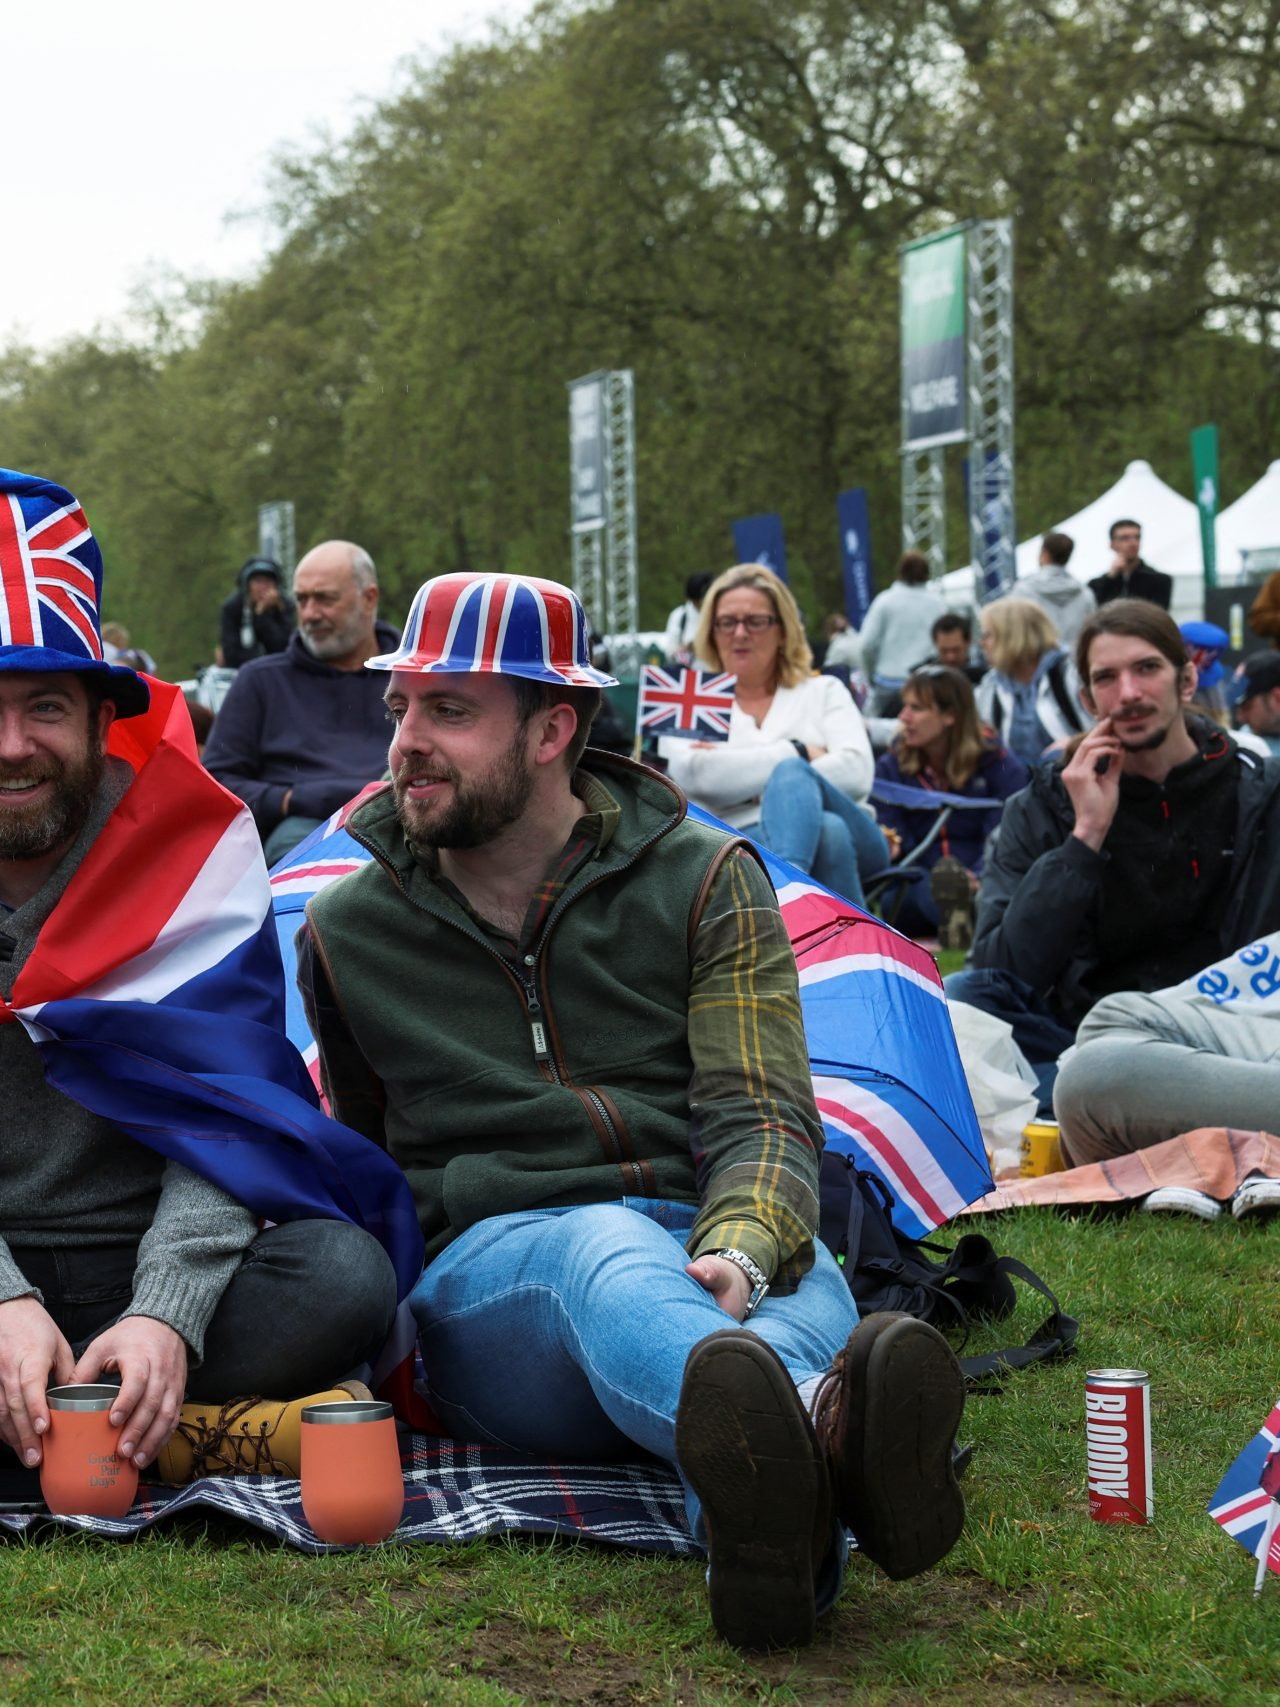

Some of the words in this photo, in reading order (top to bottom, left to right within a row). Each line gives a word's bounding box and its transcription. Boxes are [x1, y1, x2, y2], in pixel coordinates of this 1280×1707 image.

[1086, 1391, 1129, 1499] BLOODY
[88, 1453, 118, 1465] Good
[100, 1464, 120, 1476] Pair
[89, 1475, 116, 1489] Days
